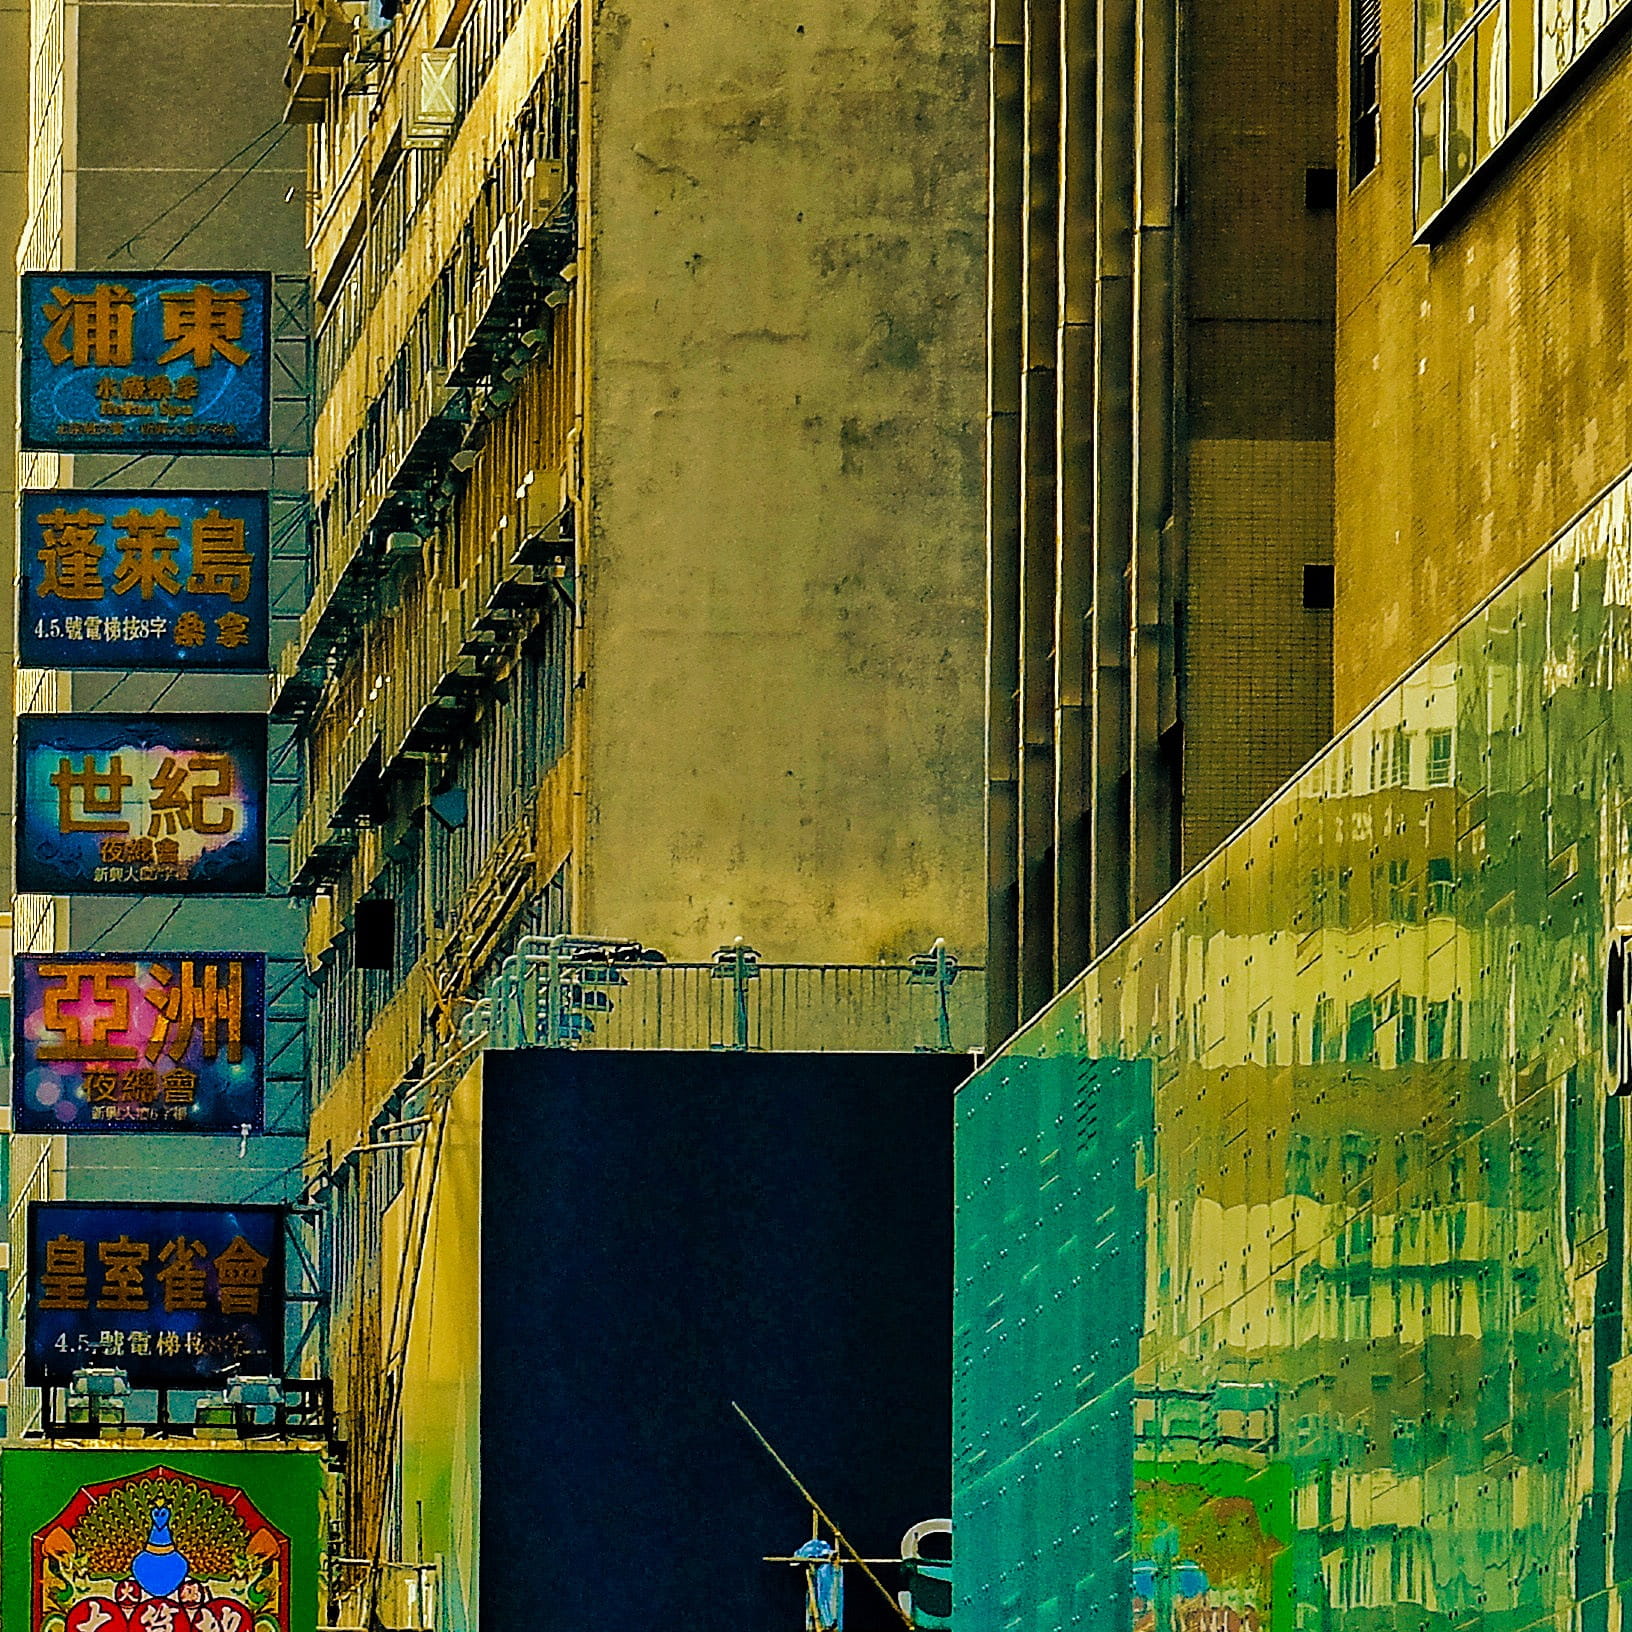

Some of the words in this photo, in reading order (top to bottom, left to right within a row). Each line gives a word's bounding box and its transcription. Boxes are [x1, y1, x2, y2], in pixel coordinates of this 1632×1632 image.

[41, 282, 253, 370] 浦東
[37, 506, 256, 604] 蓬萊島
[49, 753, 236, 838] 世紀
[37, 960, 246, 1066] 亞洲
[39, 1233, 271, 1316] 皇室雀會
